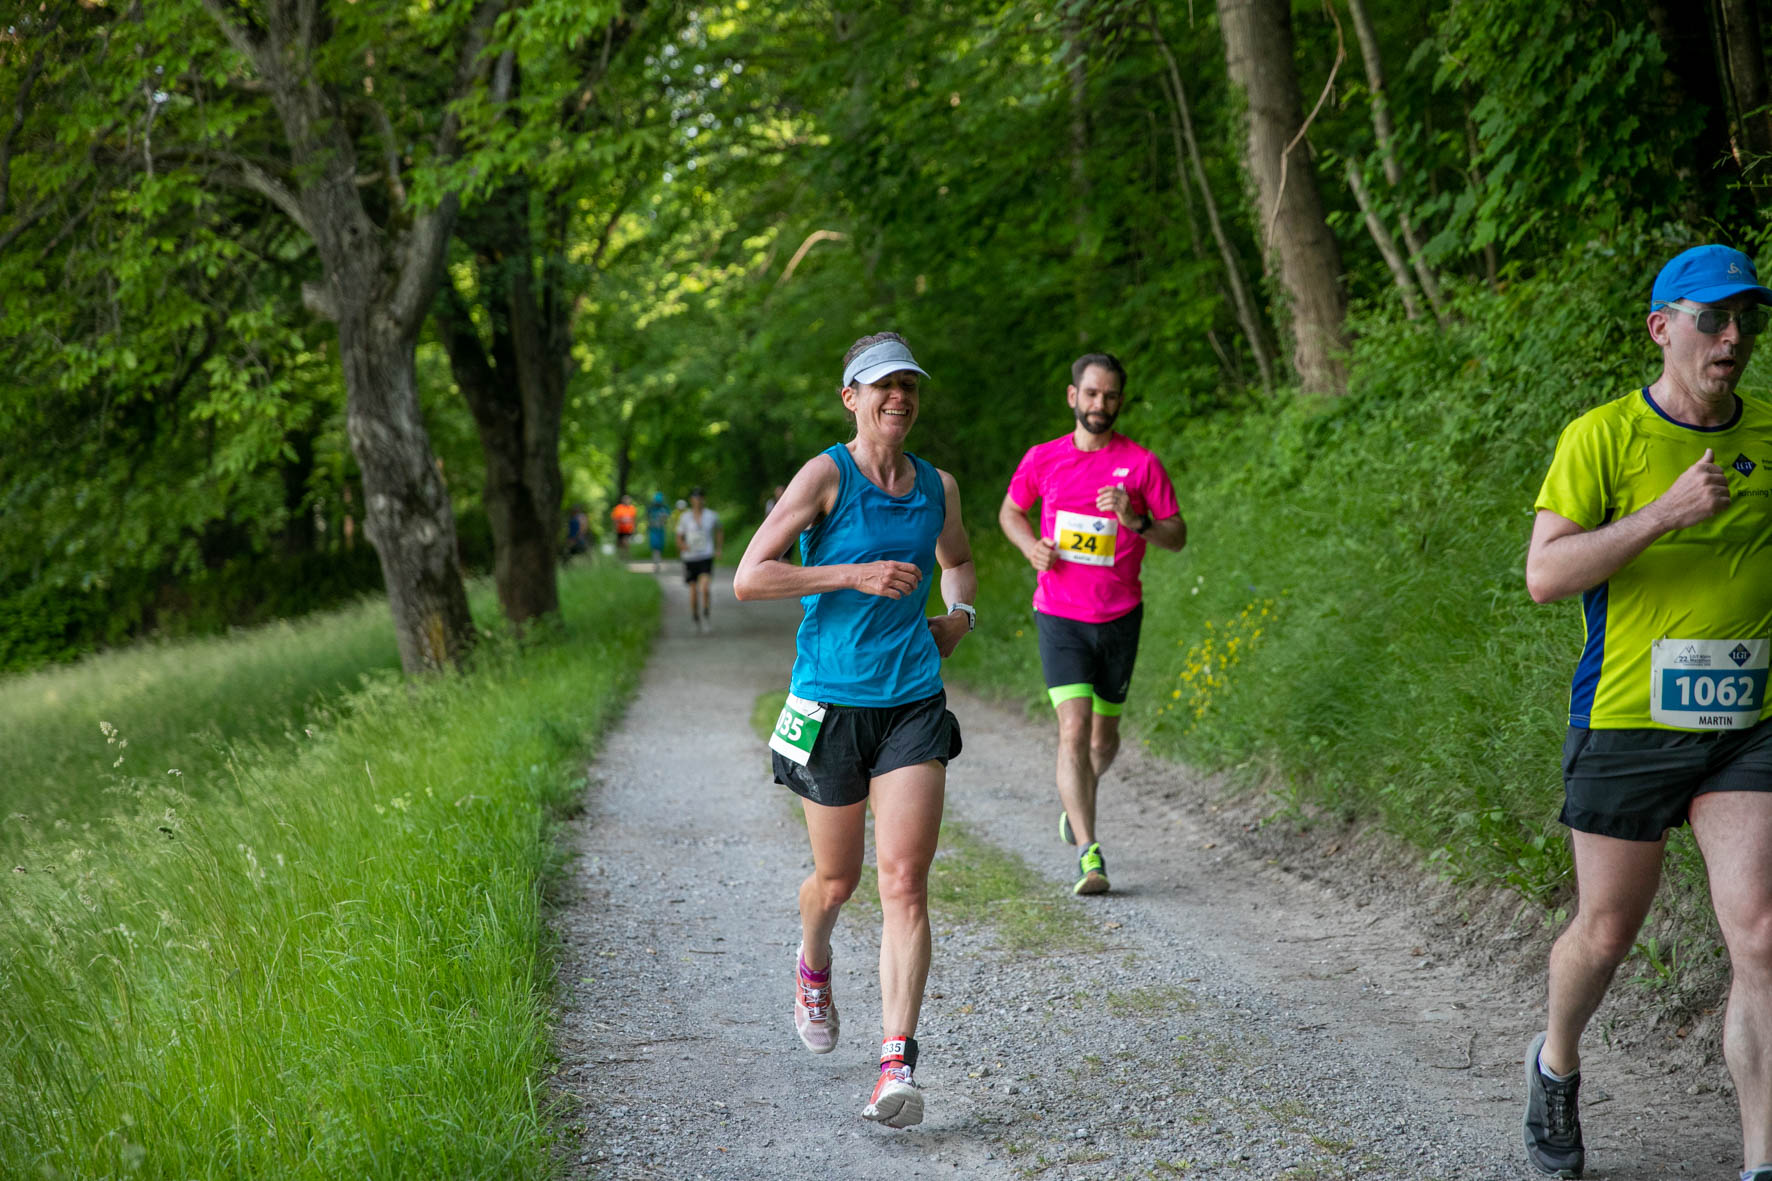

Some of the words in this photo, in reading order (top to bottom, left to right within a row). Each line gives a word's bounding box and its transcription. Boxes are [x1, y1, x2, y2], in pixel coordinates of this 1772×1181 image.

[1071, 533, 1097, 553] 24
[1675, 676, 1755, 707] 1062
[1698, 716, 1733, 726] MARTIN
